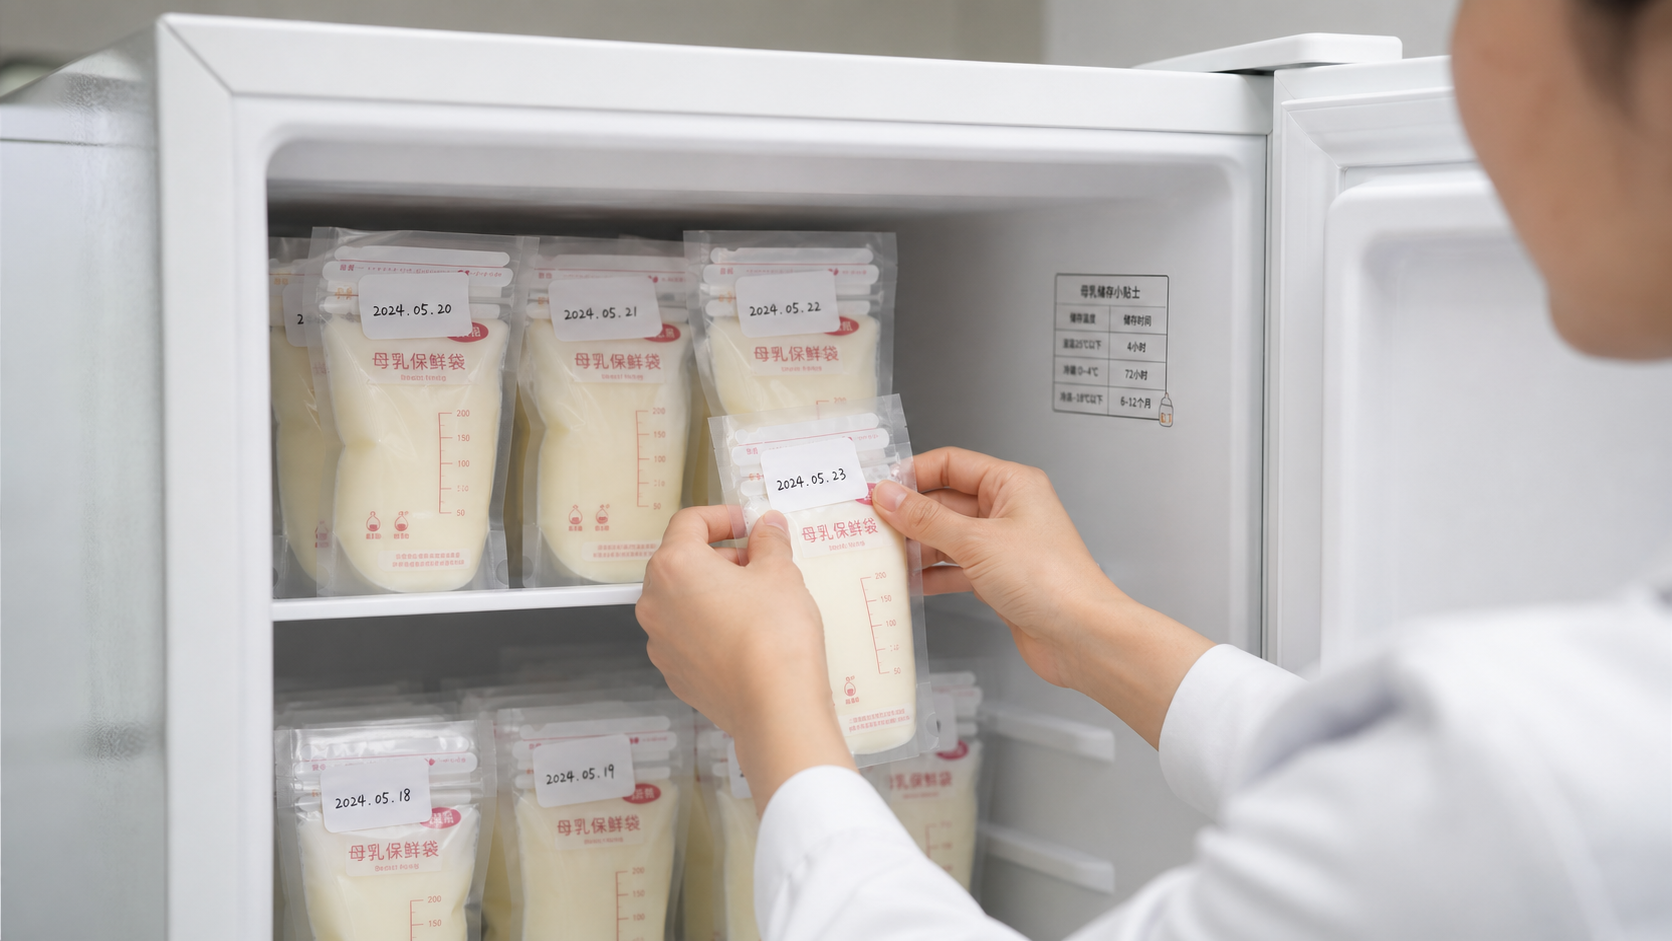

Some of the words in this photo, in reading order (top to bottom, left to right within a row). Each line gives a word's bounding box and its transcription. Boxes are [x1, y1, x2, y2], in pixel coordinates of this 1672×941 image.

[1080, 285, 1141, 299] 母乳储存小贴士
[373, 303, 452, 317] 2024.05.20
[564, 306, 637, 320] 2024.05.21
[749, 302, 822, 316] 2024.05.22
[1123, 314, 1152, 327] 储存时间
[1127, 341, 1147, 353] 4小时
[753, 346, 839, 362] 母乳保鲜袋
[372, 352, 466, 371] 母乳保鲜袋
[574, 352, 661, 370] 母乳保鲜袋
[1125, 369, 1148, 381] 72小时
[1120, 396, 1152, 409] 6-12个月
[456, 409, 471, 418] 200
[652, 407, 666, 415] 200
[457, 434, 471, 442] 150
[653, 431, 666, 439] 150
[457, 459, 470, 468] 100
[654, 455, 666, 463] 100
[776, 468, 847, 491] 2024.05.23
[653, 502, 662, 510] 50
[456, 509, 465, 517] 50
[801, 517, 878, 543] 母乳保鲜袋
[875, 571, 887, 580] 200
[880, 594, 892, 603] 150
[885, 619, 897, 627] 100
[893, 667, 901, 675] 50
[546, 764, 615, 785] 2024.05.19
[335, 788, 411, 809] 2024.05.18
[557, 815, 641, 836] 母乳保鲜袋
[348, 840, 440, 862] 母乳保鲜袋
[632, 867, 645, 875] 200
[632, 889, 646, 898] 150
[427, 895, 442, 904] 200
[632, 913, 646, 921] 100
[428, 919, 442, 928] 150
